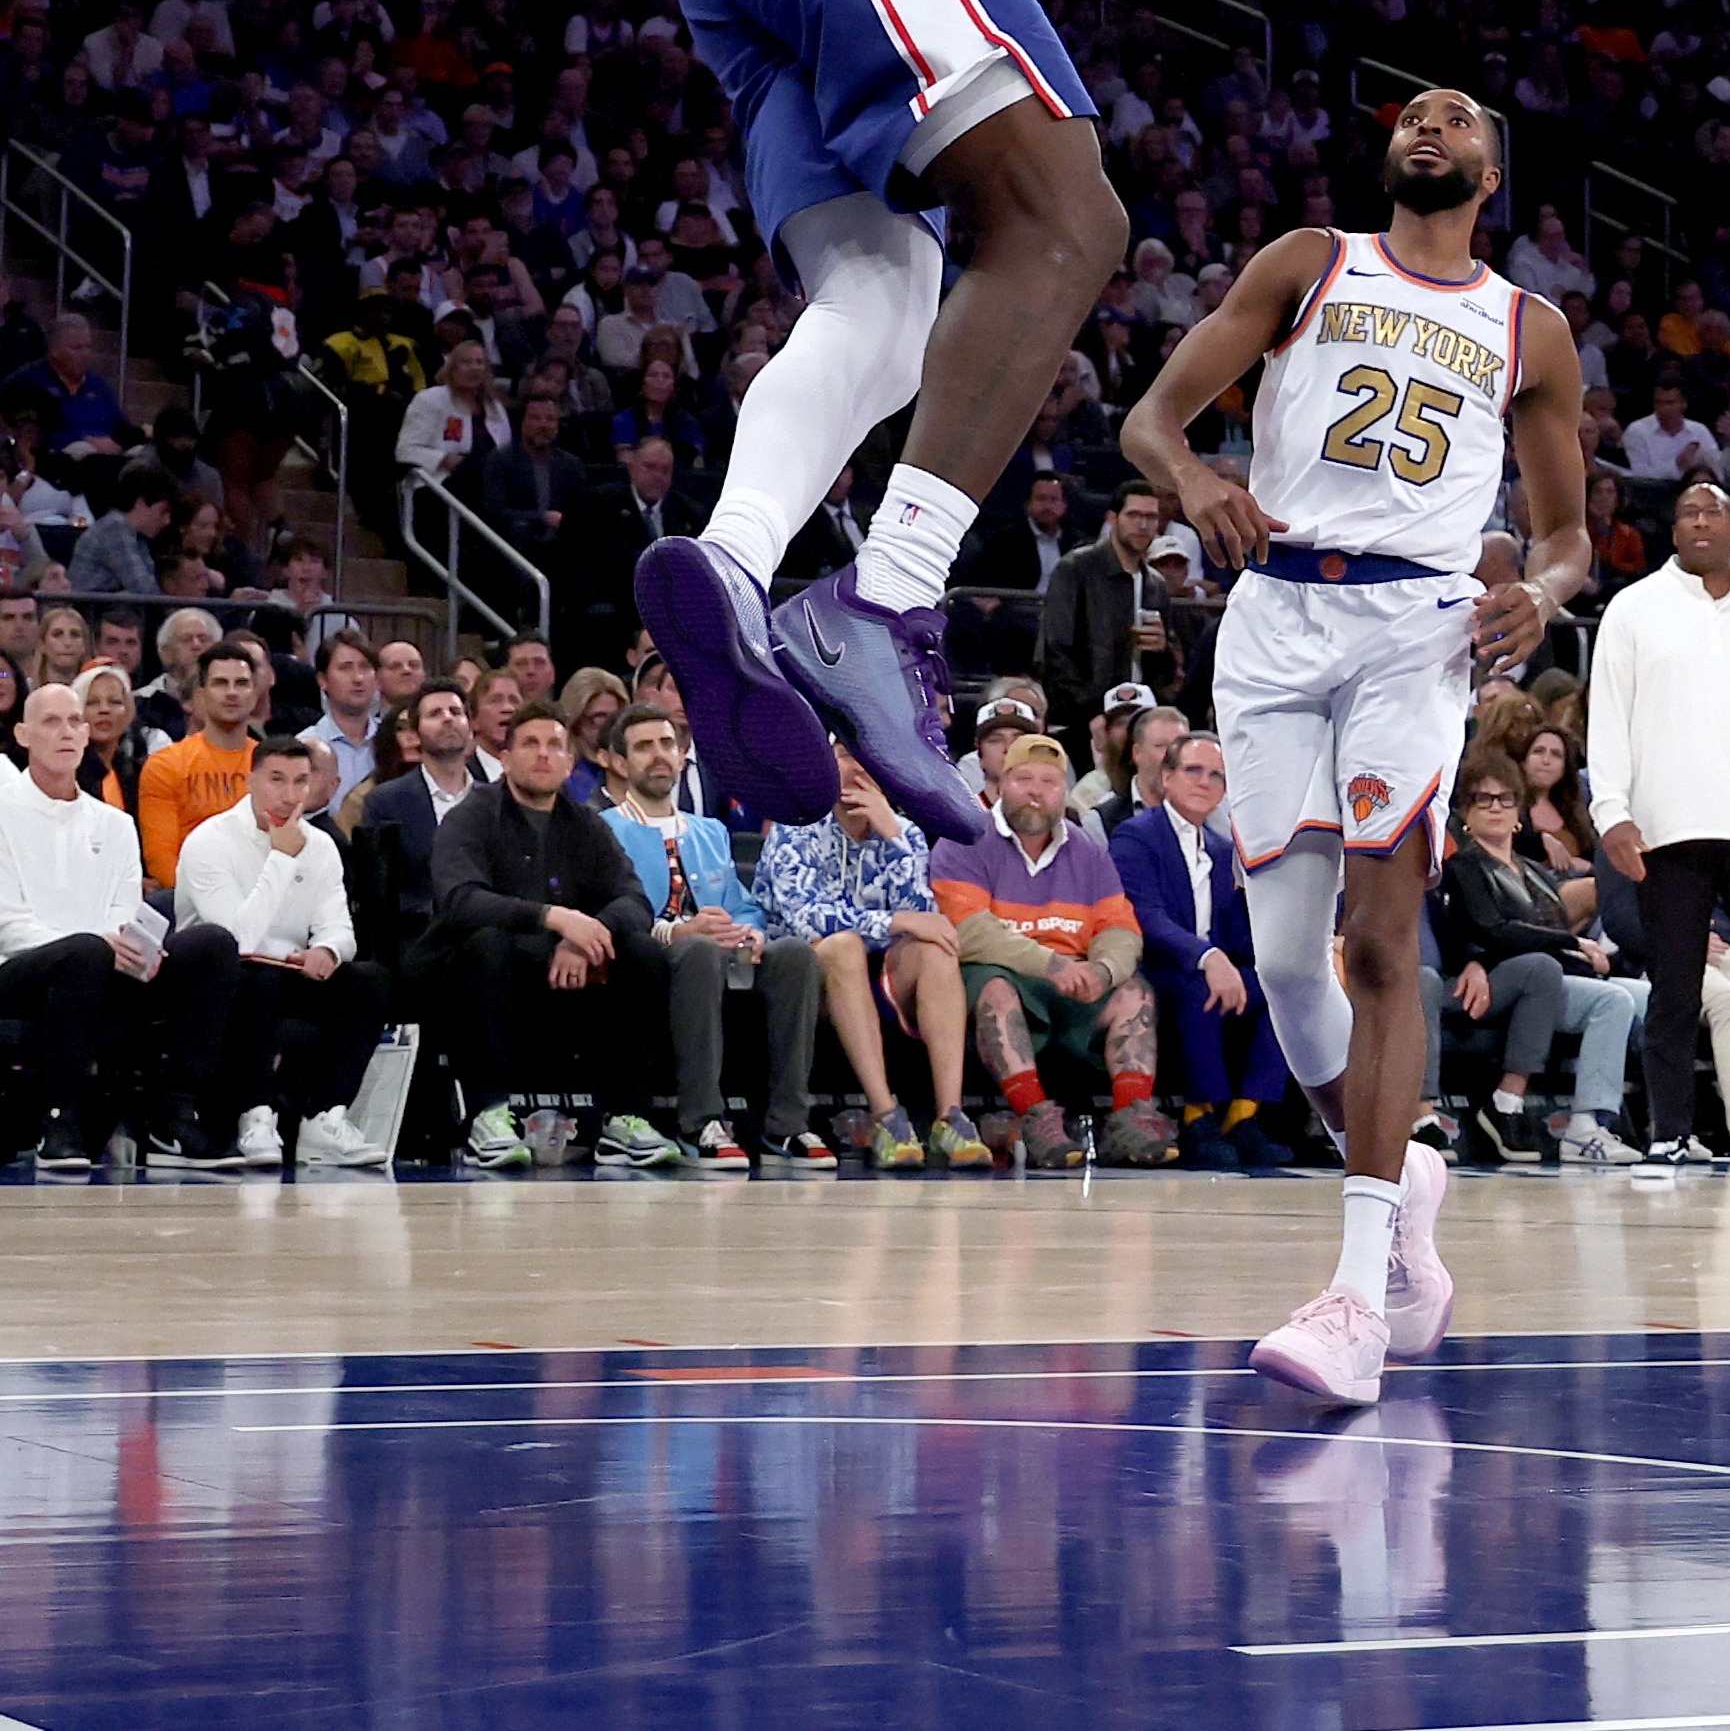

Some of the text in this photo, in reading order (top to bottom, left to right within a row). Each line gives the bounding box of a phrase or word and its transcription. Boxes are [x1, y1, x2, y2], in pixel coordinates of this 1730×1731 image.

[1316, 302, 1506, 399] NEW YORK
[1321, 364, 1465, 487] 25
